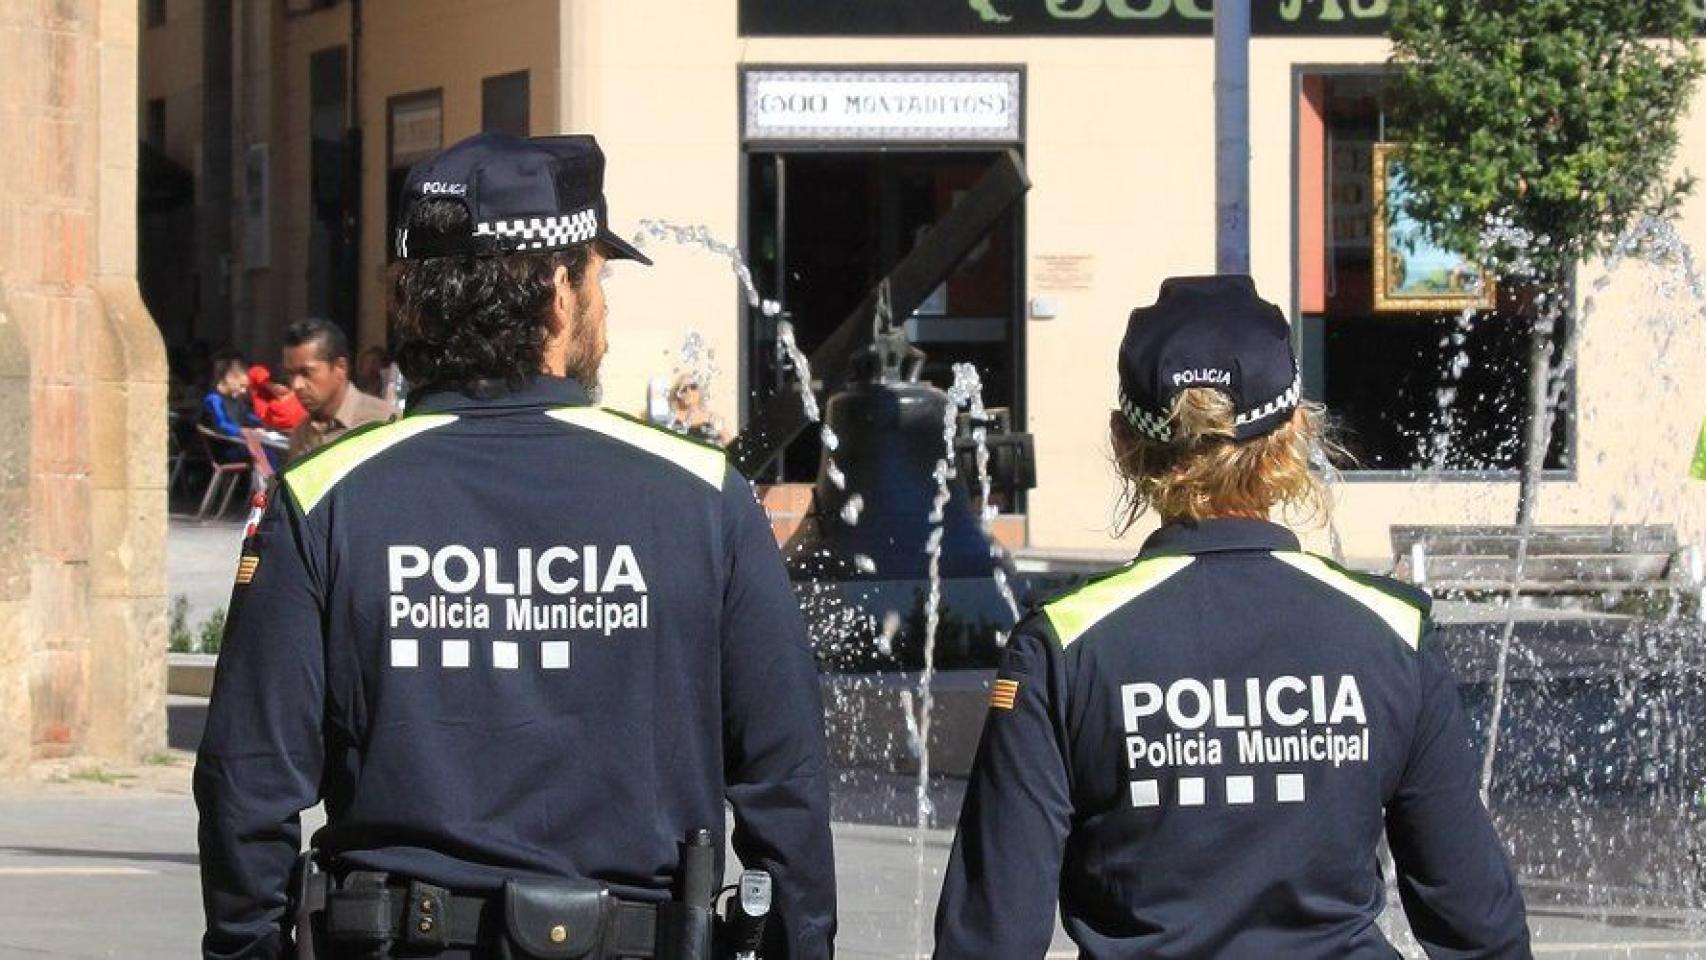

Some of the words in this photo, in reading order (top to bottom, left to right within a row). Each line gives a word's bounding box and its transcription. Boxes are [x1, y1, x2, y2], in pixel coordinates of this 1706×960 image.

[1172, 368, 1231, 387] POLICIA
[387, 544, 648, 596] POLICIA
[389, 594, 490, 630] Policia
[506, 595, 648, 637] Municipal
[1120, 673, 1367, 733] POLICIA
[1125, 731, 1223, 769] Policia
[1237, 727, 1369, 768] Municipal
